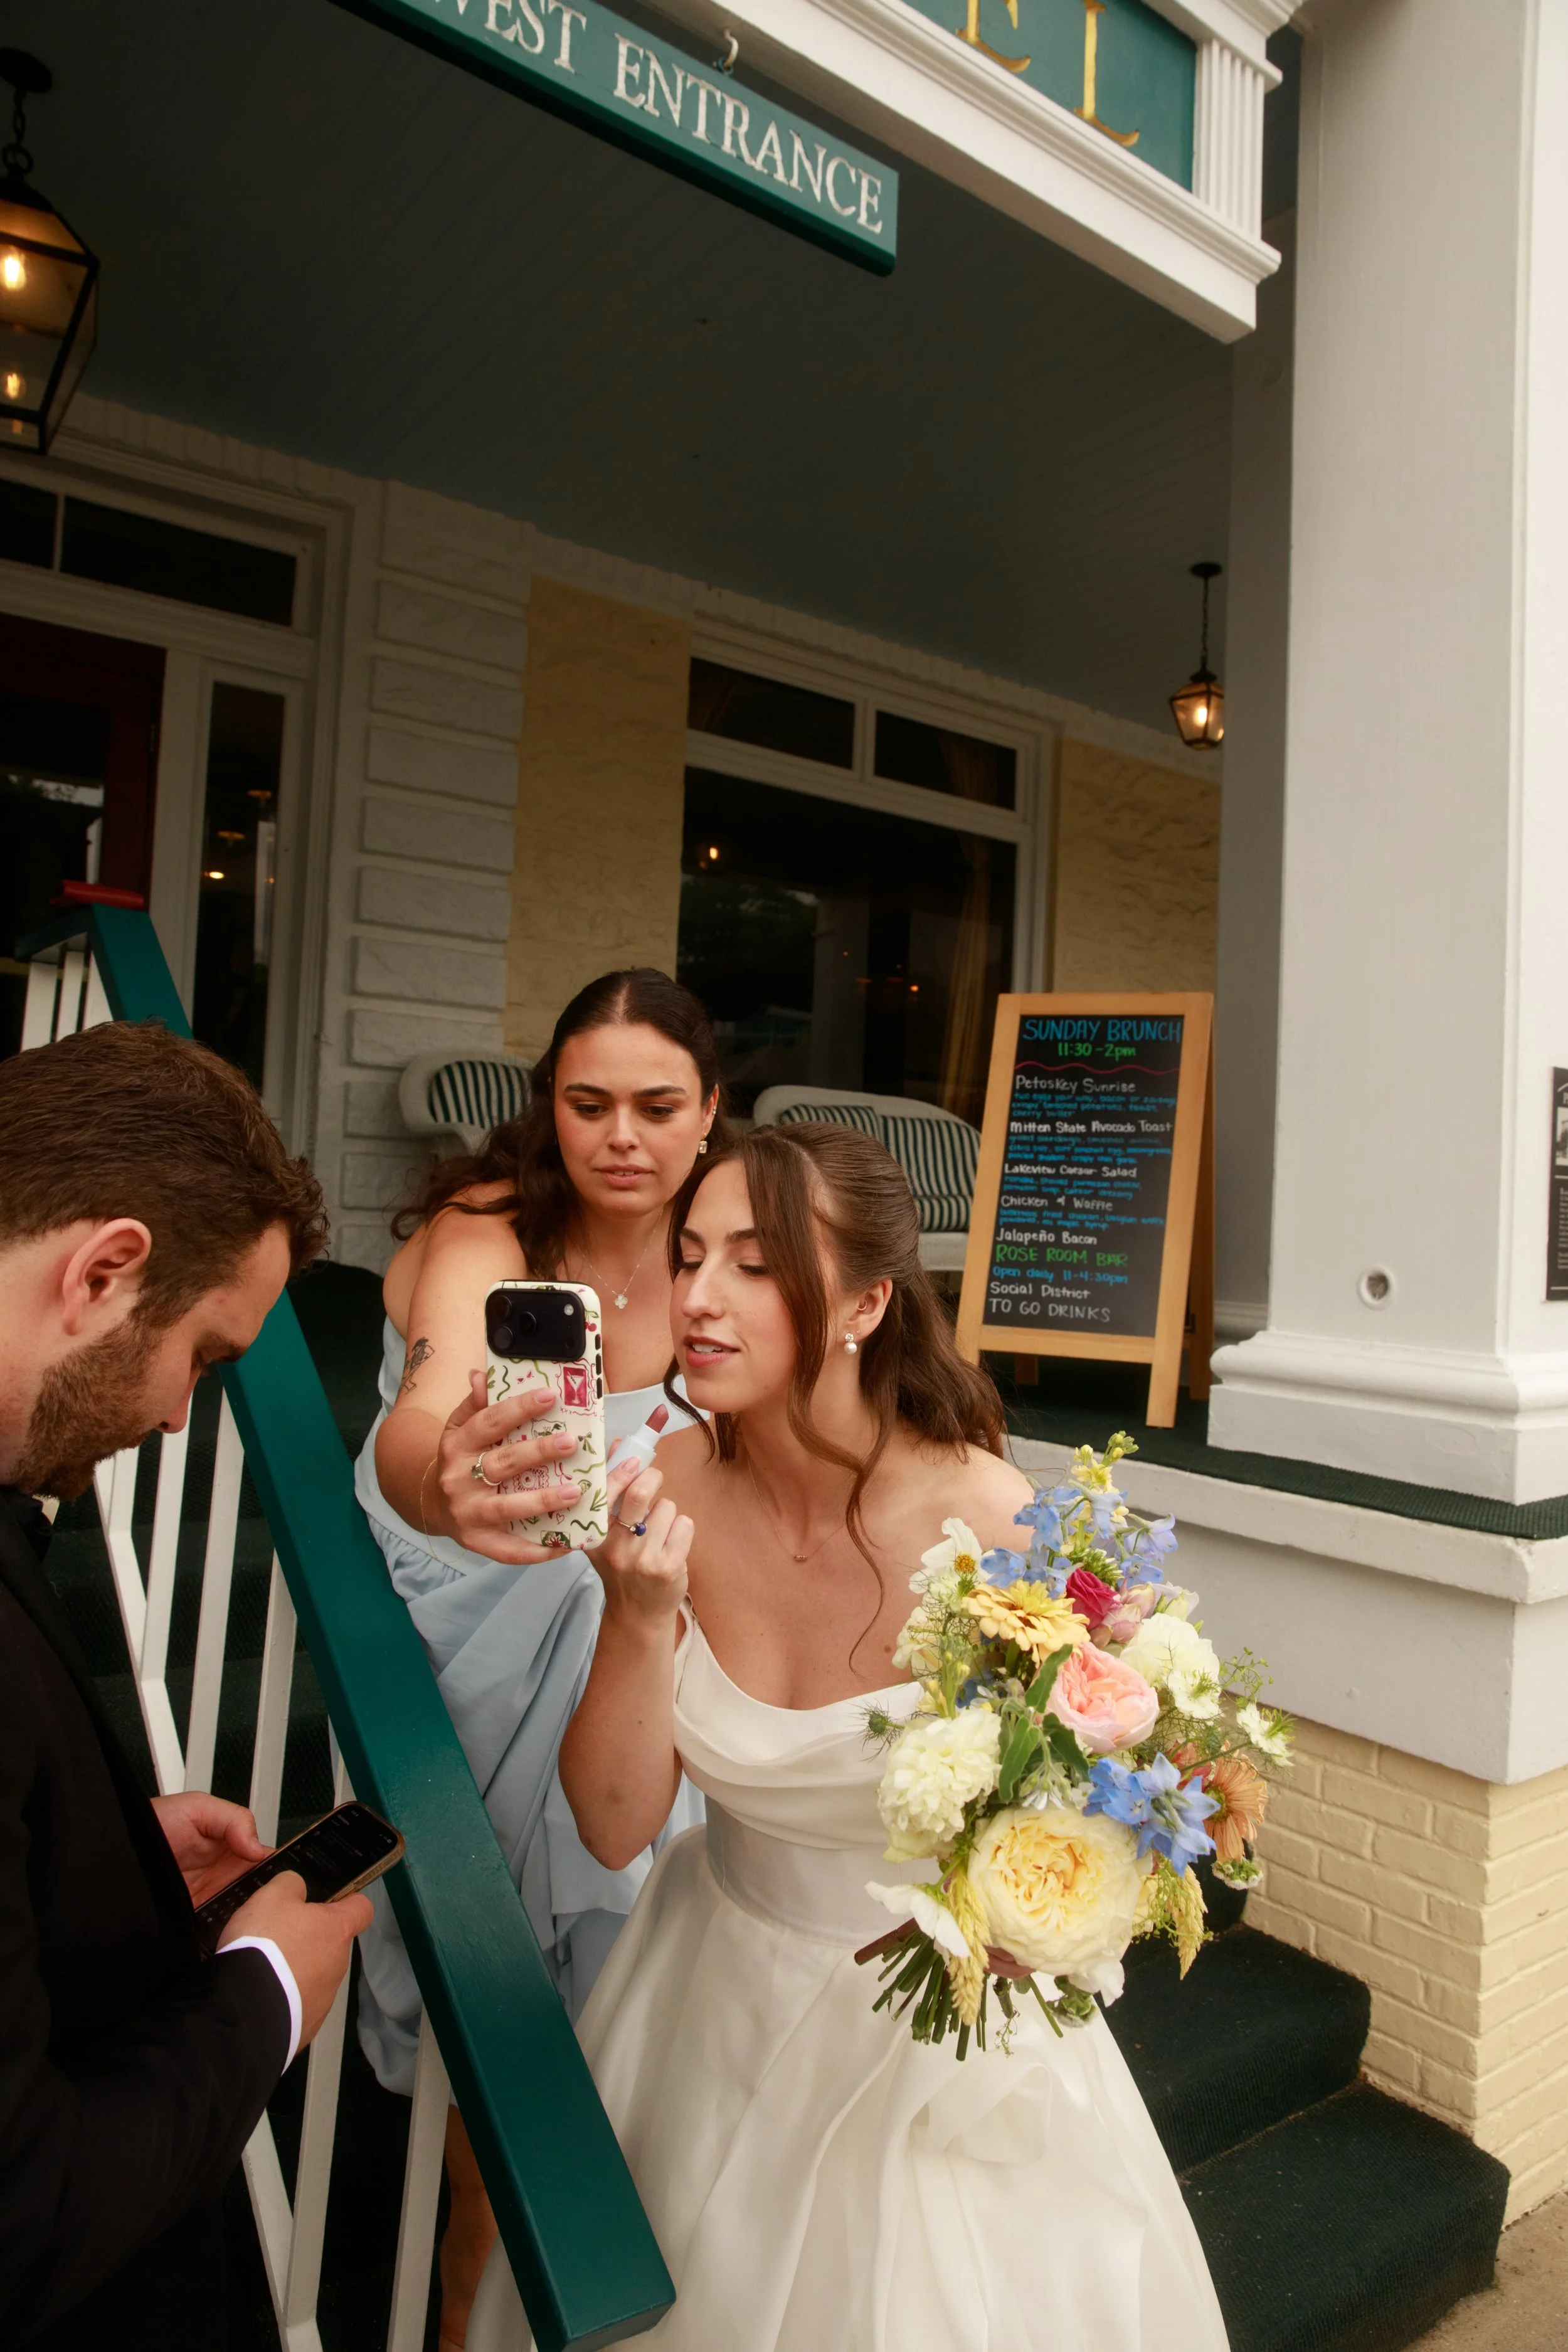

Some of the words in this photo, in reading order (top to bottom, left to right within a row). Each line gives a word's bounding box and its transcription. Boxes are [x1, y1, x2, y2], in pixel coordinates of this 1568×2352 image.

[436, 0, 587, 75] EST
[613, 33, 882, 234] ENTRANCE
[1022, 1019, 1101, 1041] SUNDAY
[1106, 1019, 1181, 1043] BRUNCH
[1057, 1042, 1092, 1056] 11:30
[1083, 1078, 1136, 1093] Sunrise
[1010, 1121, 1051, 1133] Mitten
[1056, 1121, 1086, 1133] State
[1091, 1120, 1136, 1133] Avocado
[1138, 1120, 1173, 1132] Toast
[1101, 1166, 1137, 1177] Salad
[1073, 1197, 1113, 1211] Waffle
[996, 1228, 1056, 1245] Jalapeño
[1061, 1231, 1098, 1245] Bacon
[995, 1244, 1038, 1263] ROSE
[1046, 1247, 1088, 1264] ROOM
[1096, 1252, 1128, 1266] BAR
[993, 1266, 1021, 1279] Open
[1026, 1268, 1054, 1283] daily
[990, 1281, 1033, 1295] Social
[1041, 1285, 1091, 1300] District
[989, 1298, 1012, 1313] TO
[1019, 1301, 1041, 1315] GO
[1048, 1303, 1111, 1323] DRINKS
